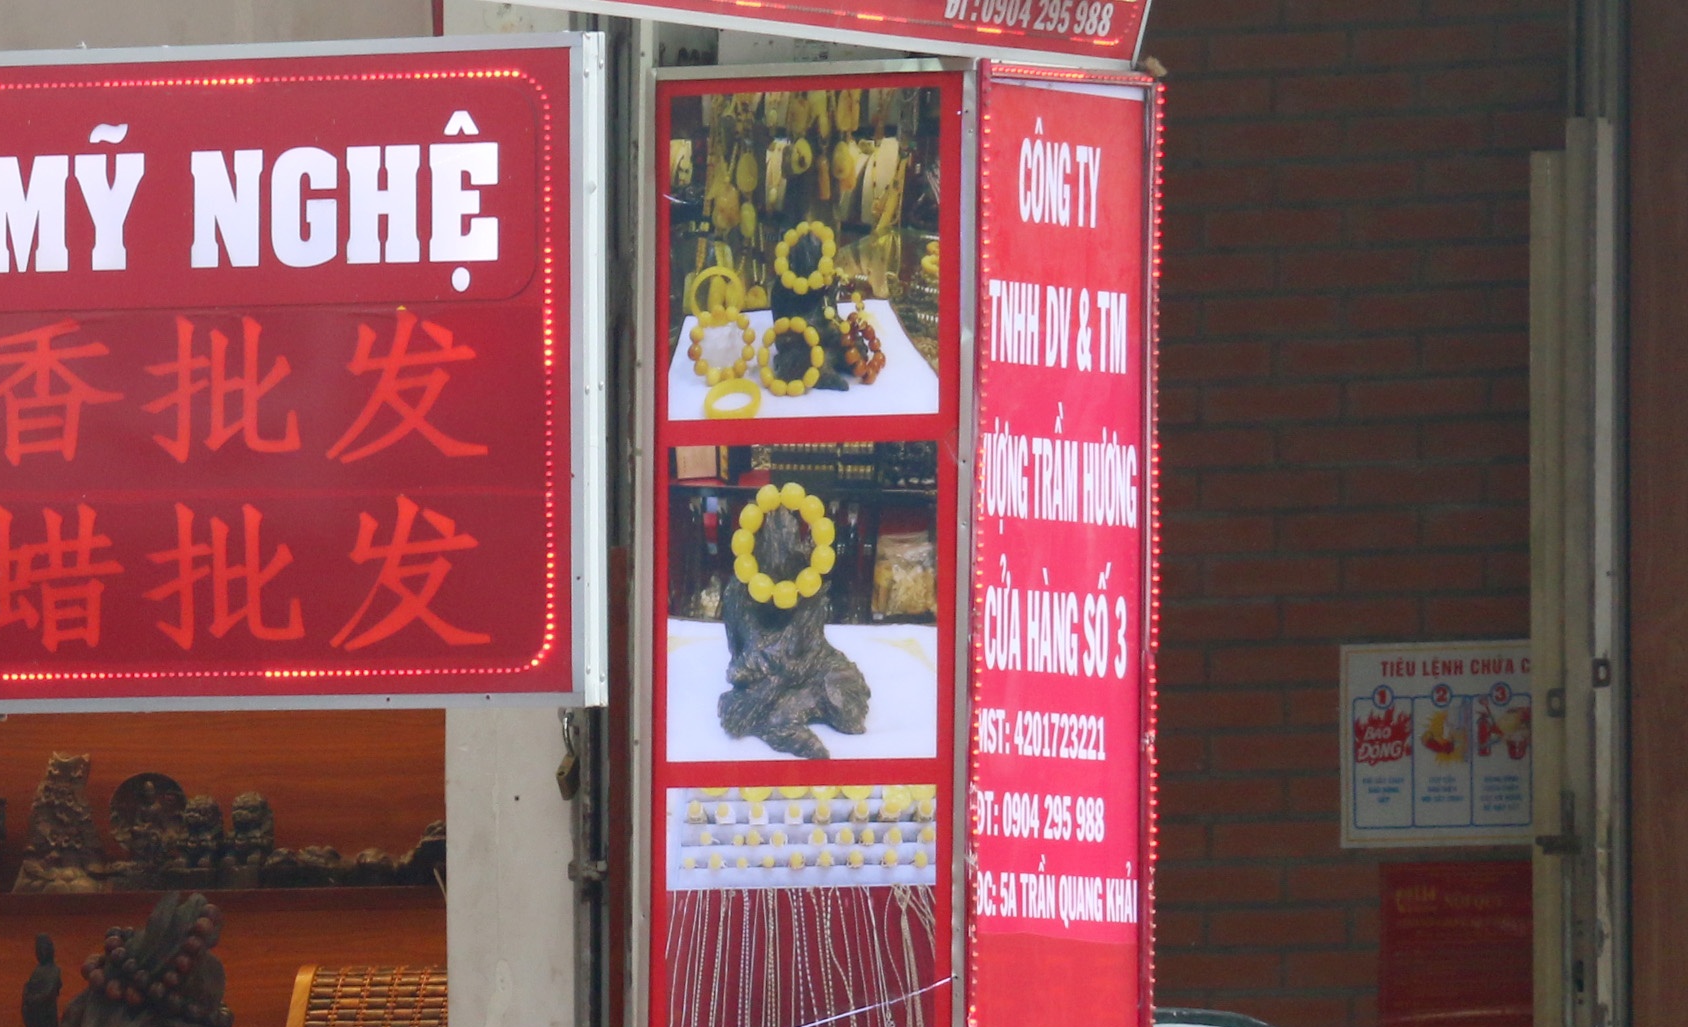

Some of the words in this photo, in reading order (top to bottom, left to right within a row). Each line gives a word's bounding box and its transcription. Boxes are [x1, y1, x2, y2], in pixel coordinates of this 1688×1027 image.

[1074, 1, 1114, 37] 988
[191, 110, 499, 293] NGHỆ
[1018, 117, 1072, 228] CÔNG
[1076, 145, 1101, 229] TY
[989, 279, 1041, 367] TNHH
[1045, 286, 1072, 370] DV
[1076, 288, 1092, 373] &
[1097, 291, 1128, 375] TM
[1032, 402, 1078, 523] TRẦM
[1083, 426, 1137, 529] HƯƠNG
[984, 554, 1021, 671] CỬA
[1027, 568, 1078, 676] HÀNG
[1082, 562, 1111, 679] SỐ
[1114, 596, 1127, 679] 3
[1014, 711, 1105, 760] 4201723221
[1002, 792, 1040, 838] 0904
[1043, 794, 1072, 841] 295
[1076, 796, 1105, 842] 988
[1000, 872, 1017, 917] 5A
[1020, 854, 1056, 919] TRẦN
[1059, 875, 1103, 928] QUANG
[1106, 861, 1137, 923] KHẢI
